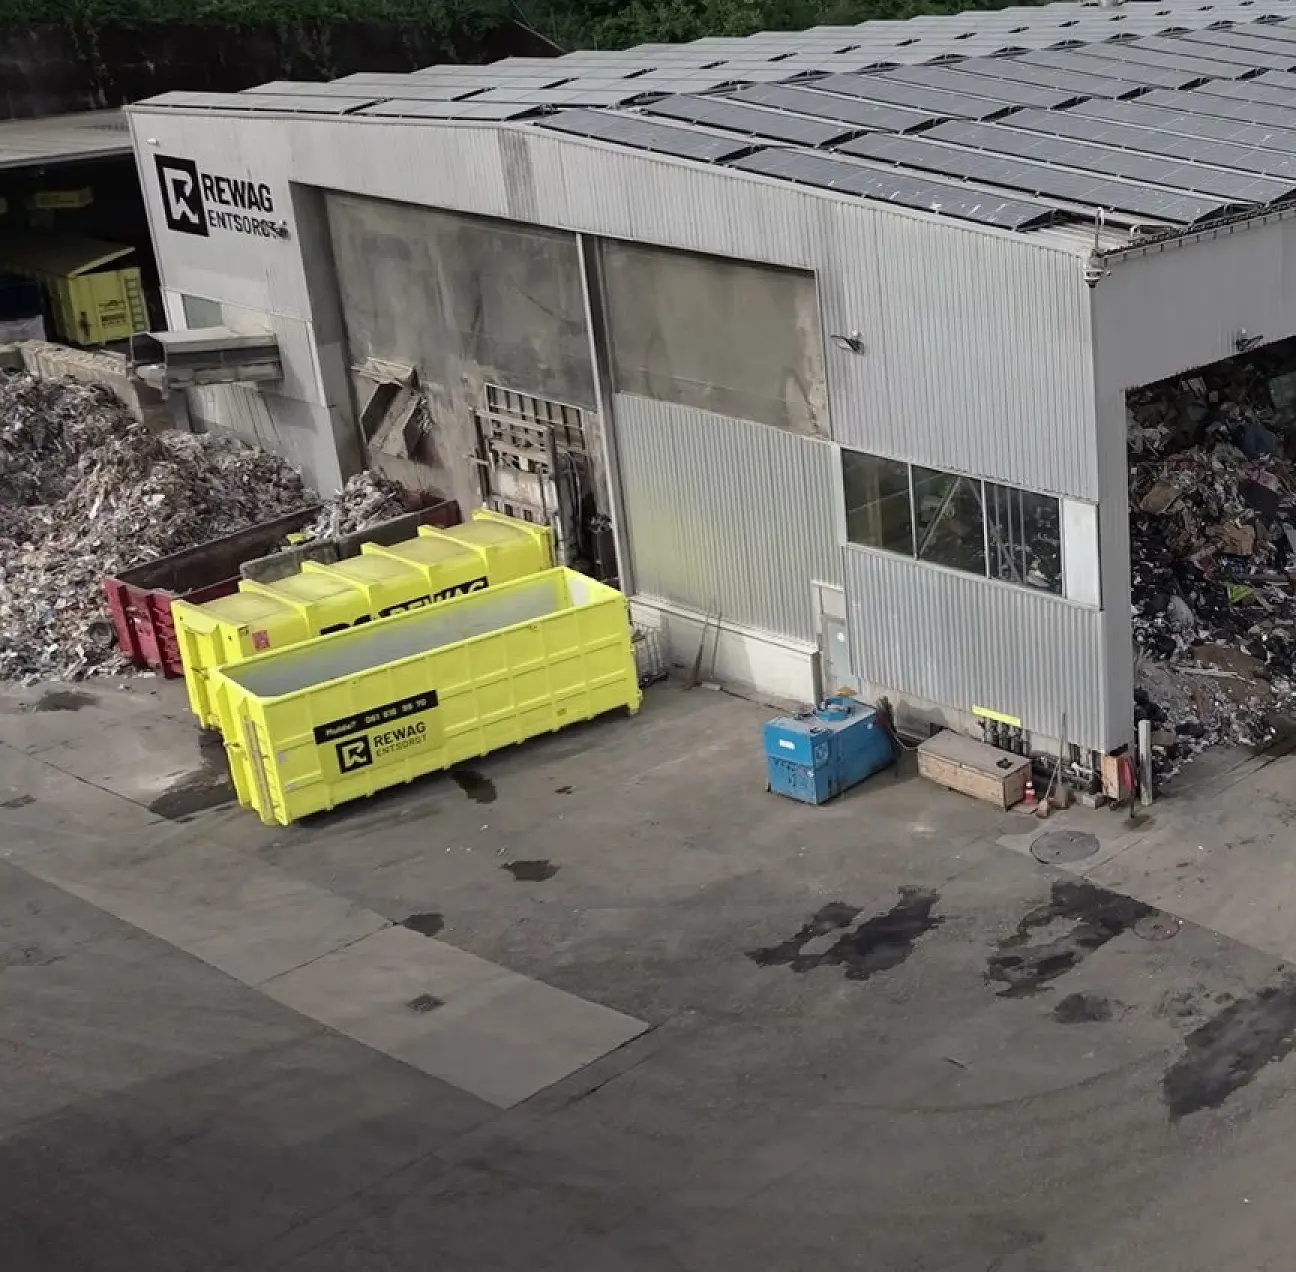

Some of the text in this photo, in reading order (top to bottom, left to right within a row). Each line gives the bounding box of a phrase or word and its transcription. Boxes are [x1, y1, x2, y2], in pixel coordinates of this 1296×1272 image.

[201, 173, 274, 214] REWAG
[373, 720, 427, 748] REWAG
[376, 734, 427, 757] ENTSORGT
